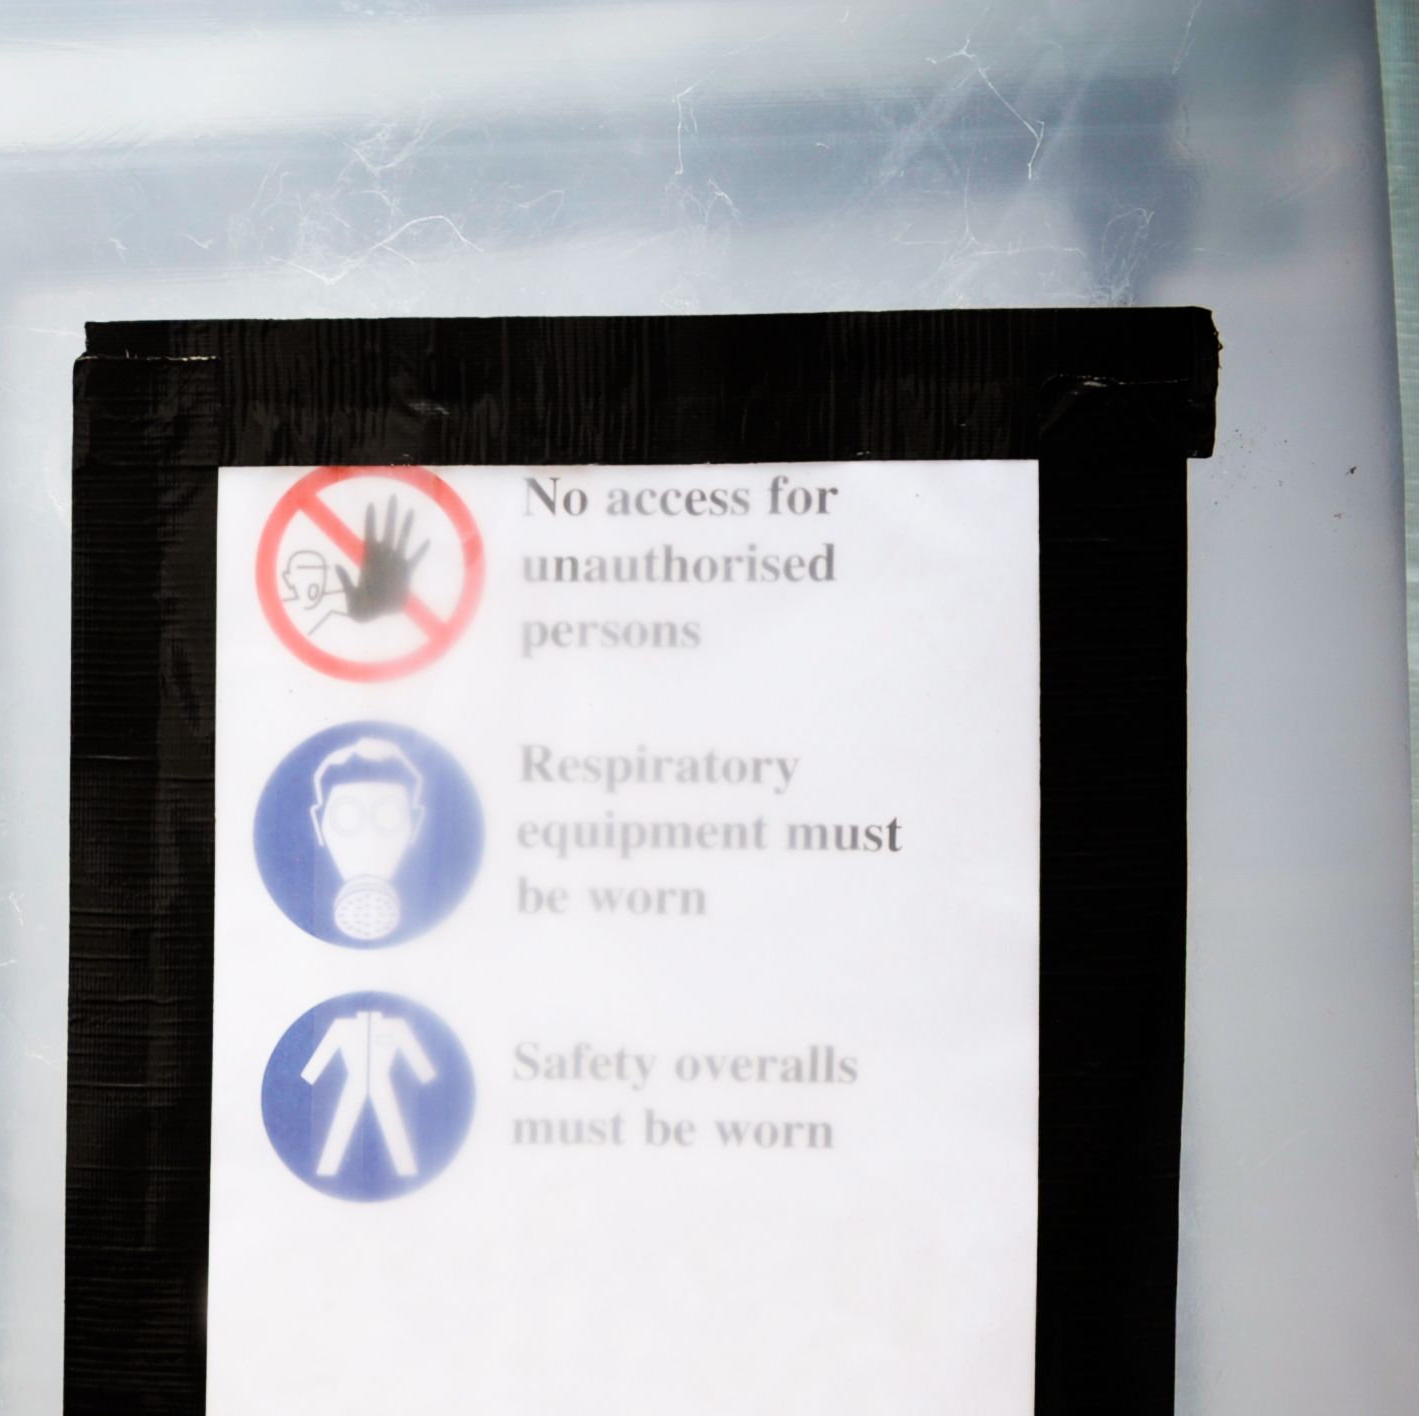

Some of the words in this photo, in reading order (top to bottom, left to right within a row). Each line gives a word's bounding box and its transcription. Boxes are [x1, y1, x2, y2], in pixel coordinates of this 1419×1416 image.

[523, 477, 589, 518] No
[607, 489, 751, 517] access
[767, 477, 838, 516] for
[522, 543, 837, 583] unauthorised
[521, 616, 701, 658] persons
[519, 744, 800, 794] Respiratory
[517, 810, 768, 859] equipment
[786, 815, 903, 852] must
[517, 877, 569, 915] be
[590, 882, 707, 915] worn
[513, 1042, 657, 1090] Safety
[674, 1046, 859, 1084] overalls
[512, 1110, 624, 1147] must
[644, 1109, 696, 1147] be
[715, 1116, 835, 1150] worn
